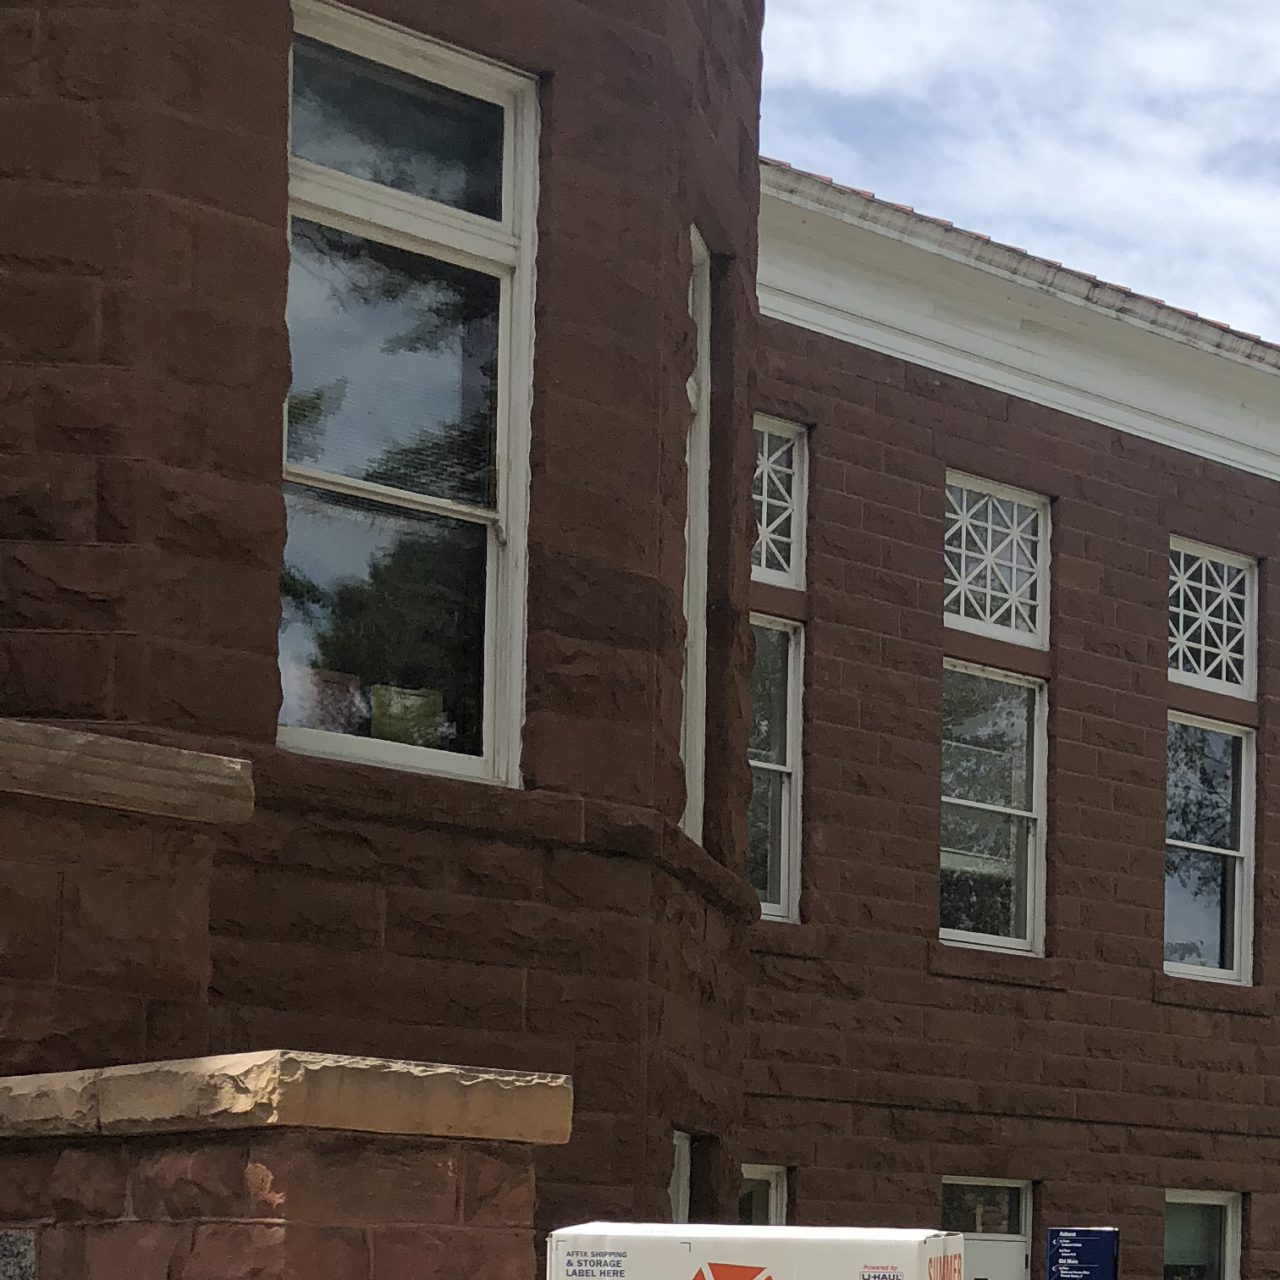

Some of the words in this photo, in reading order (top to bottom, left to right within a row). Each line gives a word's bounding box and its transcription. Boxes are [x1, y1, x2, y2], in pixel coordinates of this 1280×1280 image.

[566, 1250, 588, 1258] AFFIX
[590, 1250, 628, 1258] SHIPPING
[566, 1259, 574, 1267] &
[576, 1259, 622, 1268] STORAGE
[566, 1269, 597, 1278] LABEL
[599, 1269, 626, 1278] HERE
[861, 1273, 902, 1280] U-HAUL
